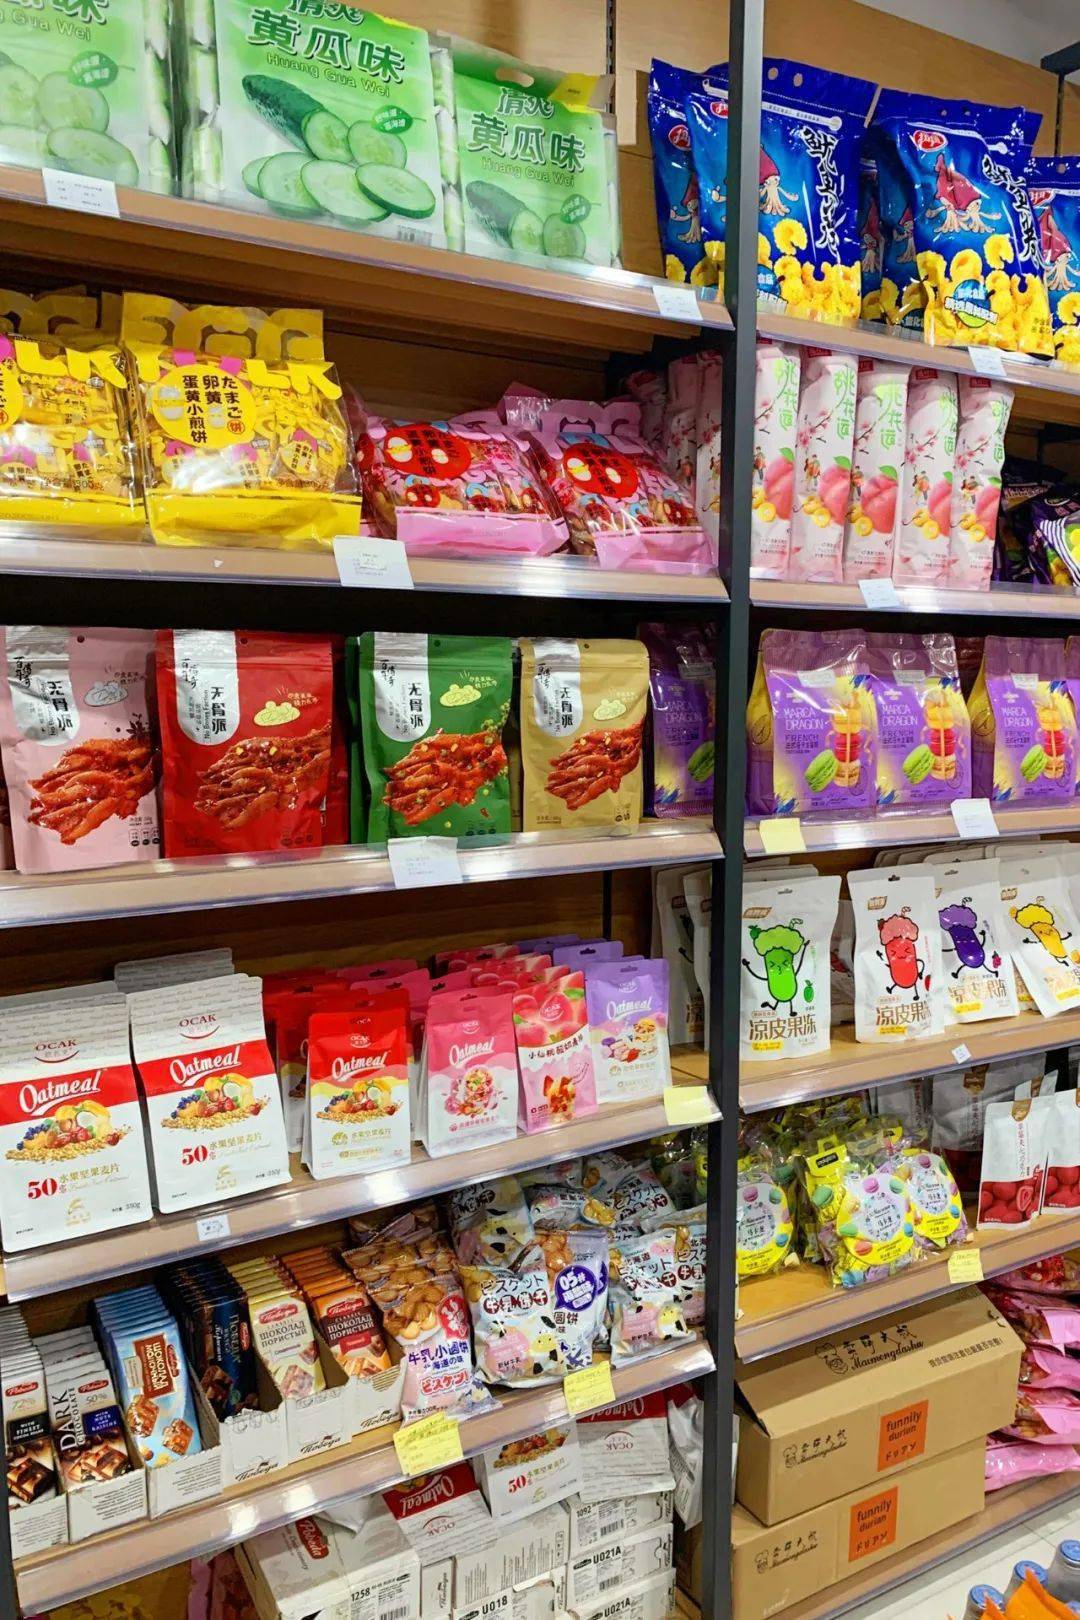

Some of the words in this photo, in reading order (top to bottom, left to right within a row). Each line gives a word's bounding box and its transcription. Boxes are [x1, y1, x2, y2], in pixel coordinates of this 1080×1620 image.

[56, 18, 91, 41] Wei
[246, 8, 405, 83] 黄瓜味
[266, 52, 320, 79] Huang
[324, 68, 357, 88] Gua
[361, 77, 391, 98] Wei
[466, 112, 586, 173] 黄瓜味
[481, 157, 521, 179] Huang
[525, 166, 550, 182] Gua
[553, 171, 575, 188] Wei
[202, 375, 223, 405] 卵黄
[221, 375, 243, 420] たまご
[182, 374, 208, 444] 蛋黄小煎饼
[210, 687, 227, 735] 无骨派
[408, 682, 424, 729] 无骨派
[560, 686, 574, 728] 无骨派
[881, 704, 912, 715] MARCA
[785, 719, 824, 731] DRAGON
[882, 715, 918, 727] DRAGON
[1003, 716, 1034, 727] DRAGON
[785, 734, 819, 742] FRENCH
[606, 995, 654, 1021] Oatmeal
[178, 1013, 217, 1028] OCAK
[749, 1013, 817, 1041] 凉皮果冻
[35, 1038, 77, 1051] OCAK
[449, 1036, 496, 1069] Oatmeal
[169, 1044, 243, 1087] Oatmeal
[331, 1050, 389, 1082] Oatmeal
[19, 1070, 102, 1114] Oatmeal
[259, 1321, 306, 1341] ШОКОЛАД
[327, 1313, 373, 1334] ШОКОЛАД
[329, 1321, 375, 1341] ПОРИСТЫЙ
[261, 1329, 308, 1348] ПОРИСТЫЙ
[145, 1344, 161, 1391] МОЛОЧНЫЙ
[153, 1342, 170, 1389] ШОКОЛАД
[52, 1389, 79, 1452] DARK
[68, 1386, 87, 1447] CHOCOLATE
[886, 1410, 922, 1432] funnily
[888, 1424, 917, 1442] durian
[300, 1436, 342, 1454] Победа
[605, 1441, 634, 1452] OCAK
[235, 1462, 280, 1482] Победа
[400, 1474, 455, 1517] Oatmeal
[575, 1505, 592, 1518] 1092
[857, 1499, 892, 1523] funnily
[859, 1514, 887, 1533] durian
[299, 1517, 324, 1559] Pobeda
[592, 1545, 623, 1565] U021A
[350, 1587, 371, 1603] 1258
[481, 1595, 508, 1615] U018
[603, 1597, 632, 1617] U021A
